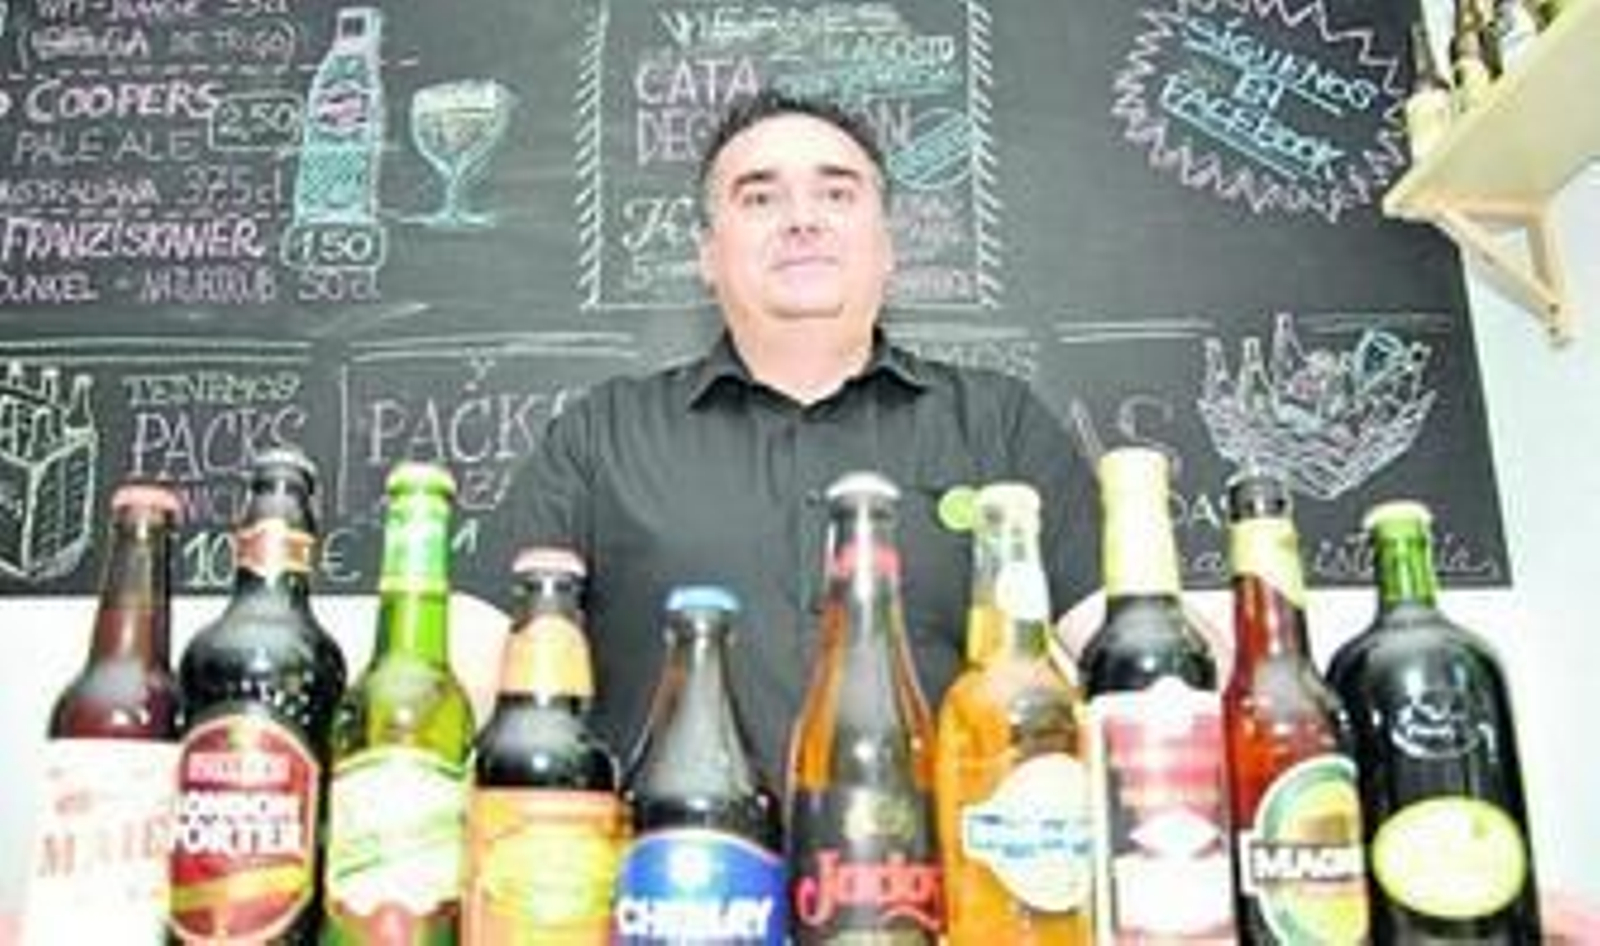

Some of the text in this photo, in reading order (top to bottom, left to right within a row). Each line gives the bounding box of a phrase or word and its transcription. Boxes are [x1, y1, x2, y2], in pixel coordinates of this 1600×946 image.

[635, 56, 760, 105] CATA
[113, 132, 202, 163] ALE
[122, 372, 302, 407] TENEMOS
